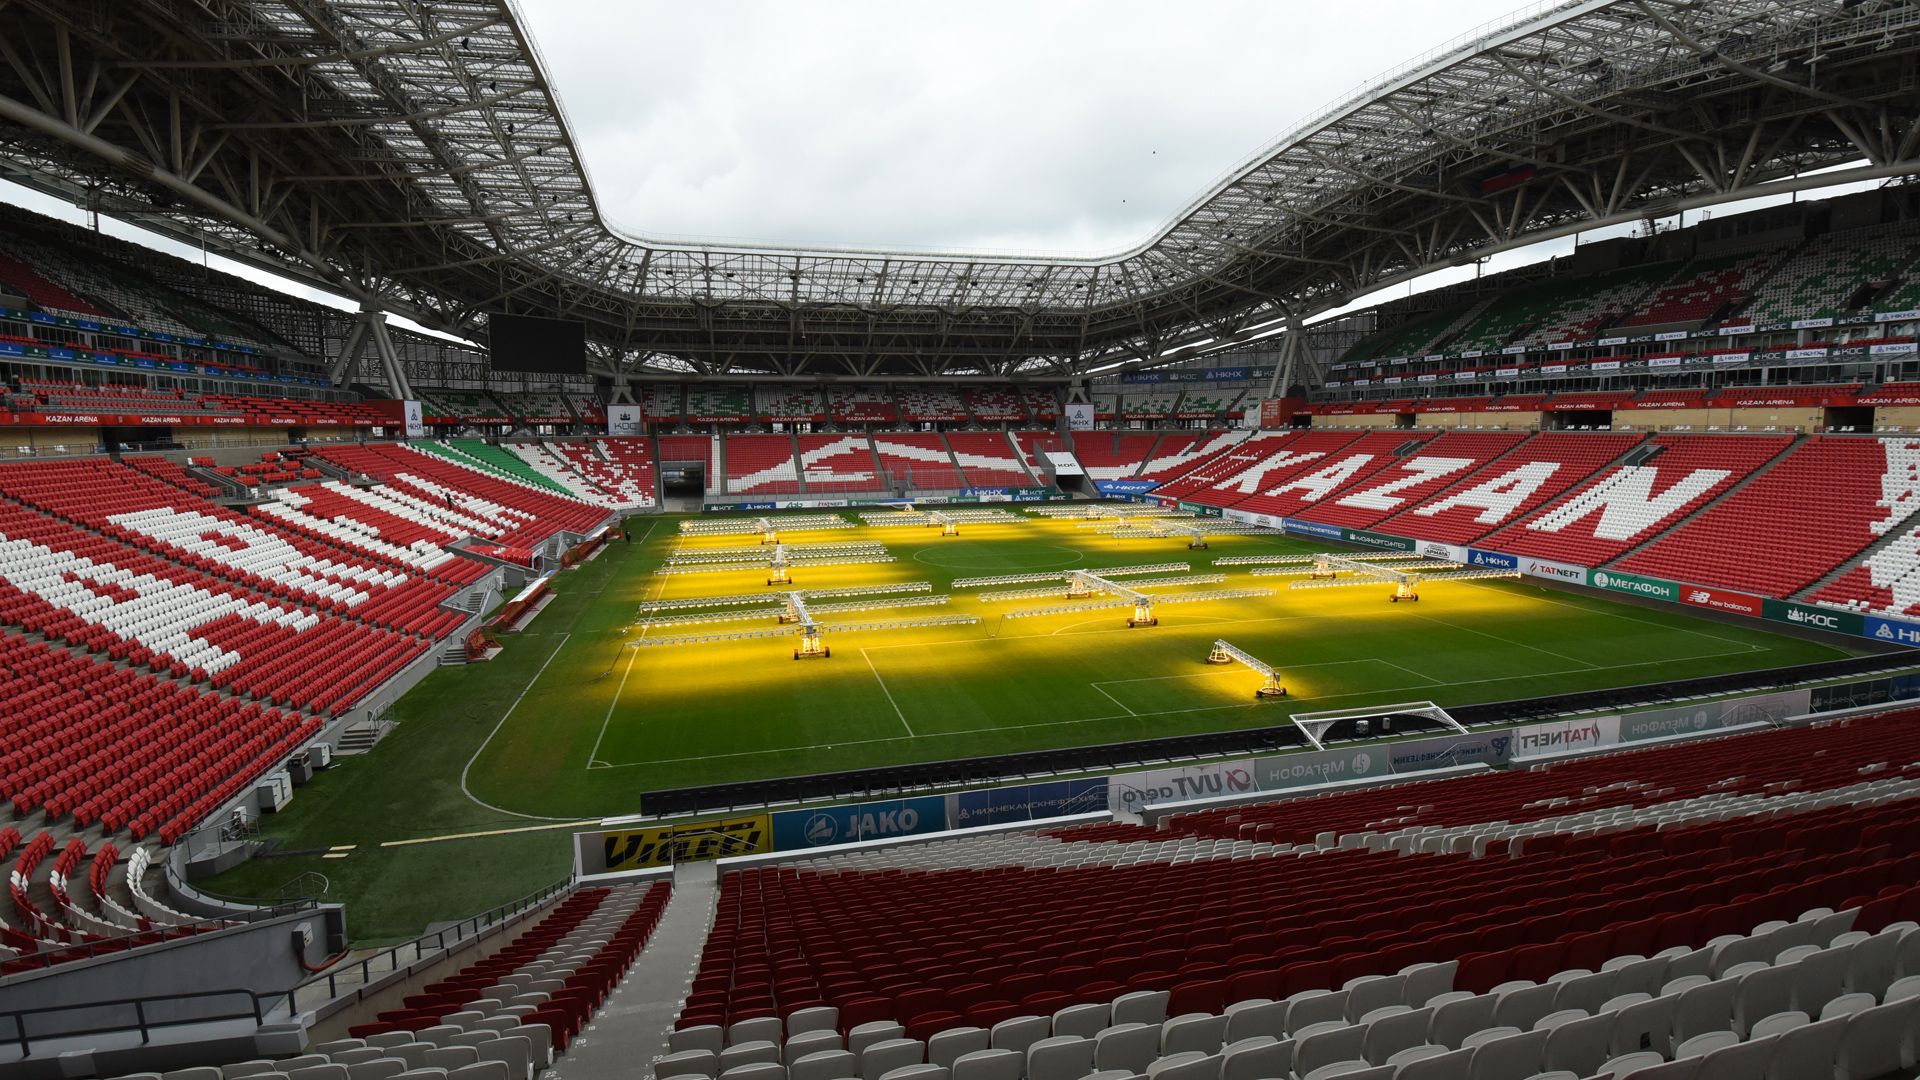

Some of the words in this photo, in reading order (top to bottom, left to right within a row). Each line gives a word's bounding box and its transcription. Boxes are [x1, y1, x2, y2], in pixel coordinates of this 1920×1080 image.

[1216, 370, 1242, 378] НКНХ
[614, 422, 637, 430] КОС
[1213, 451, 1732, 541] KAZAN
[1486, 557, 1510, 566] НКНХ
[1540, 566, 1580, 579] TATNEFT
[1724, 601, 1752, 612] balance
[1804, 612, 1838, 628] КОС
[846, 808, 919, 838] JAKO
